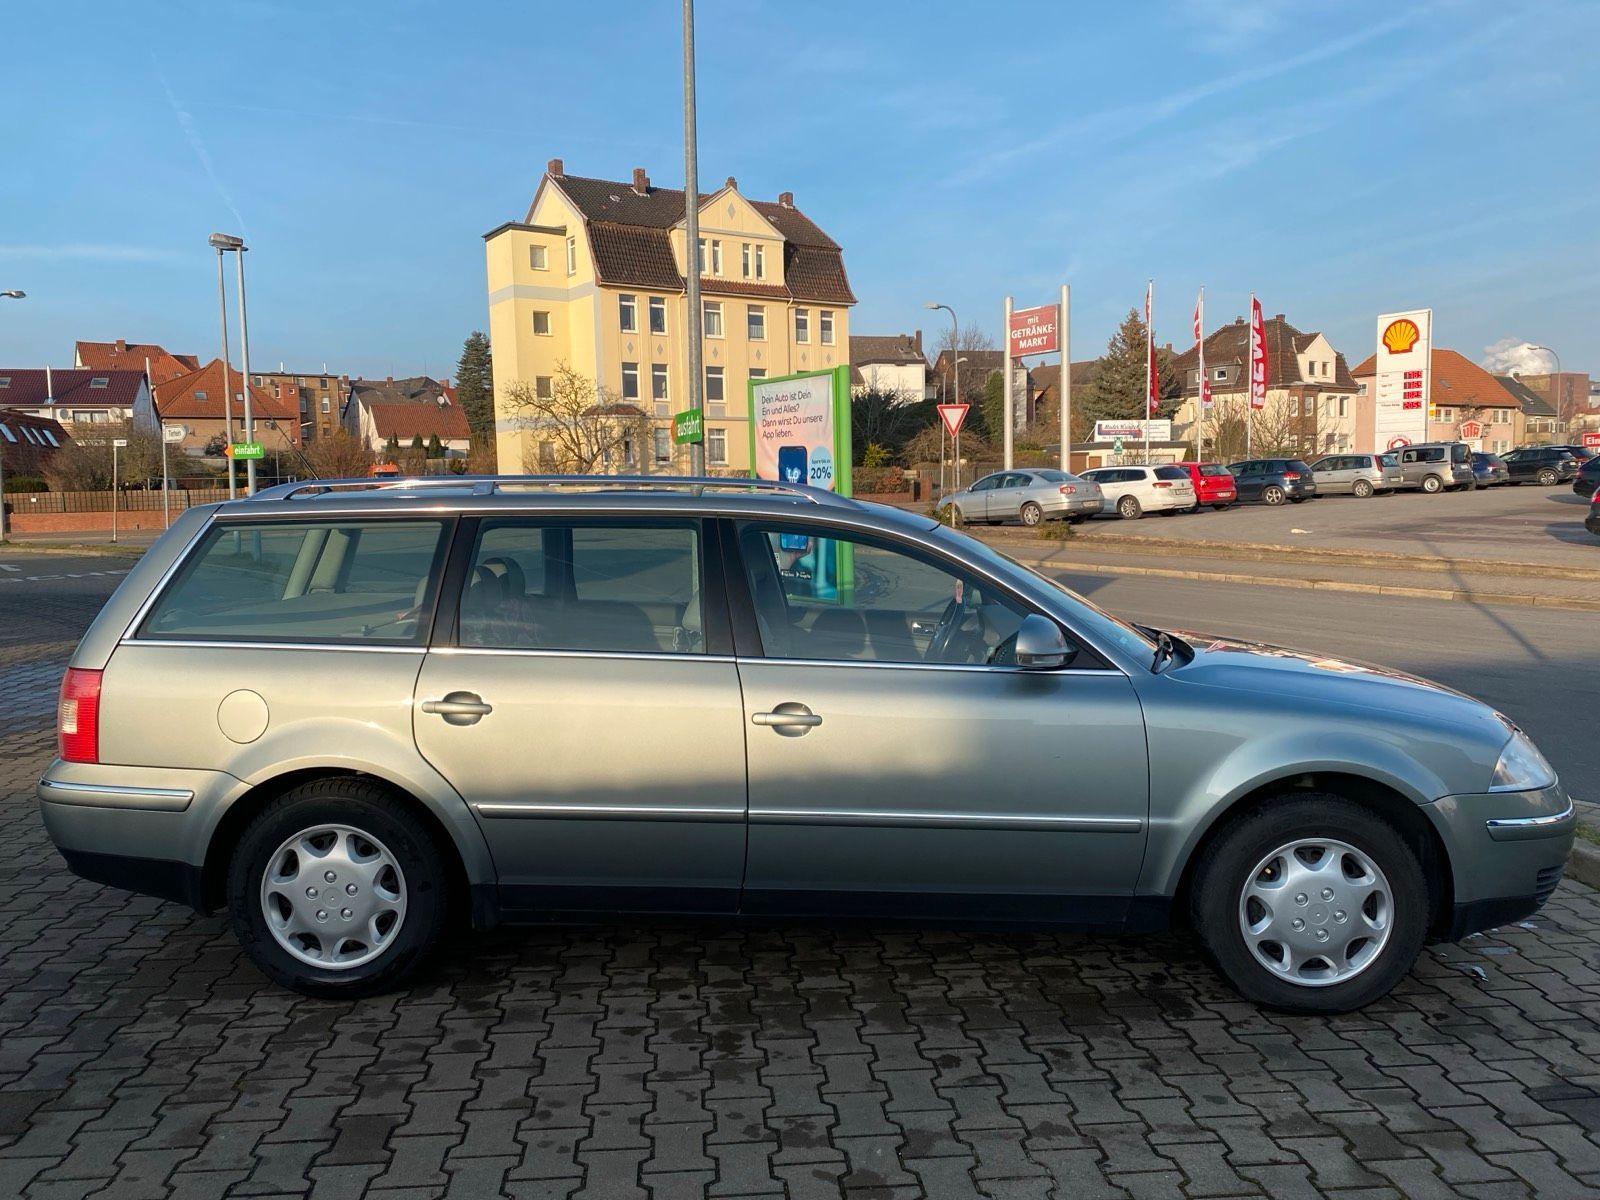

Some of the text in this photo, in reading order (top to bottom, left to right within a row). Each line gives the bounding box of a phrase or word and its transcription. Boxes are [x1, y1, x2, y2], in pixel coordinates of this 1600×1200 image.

[1027, 315, 1039, 325] mit
[1011, 324, 1056, 339] GETRÄNKE-
[1019, 335, 1048, 349] MARKT
[762, 396, 774, 404] Dein
[775, 394, 788, 402] Auto
[798, 390, 811, 400] Dein
[771, 405, 782, 413] und
[784, 403, 800, 412] Alles?
[677, 415, 700, 436] ausfahrt
[762, 415, 823, 427] Dann wirst Du unsere
[763, 429, 793, 439] App lieben.
[1462, 422, 1480, 437] UTA
[234, 445, 261, 455] einfahrt
